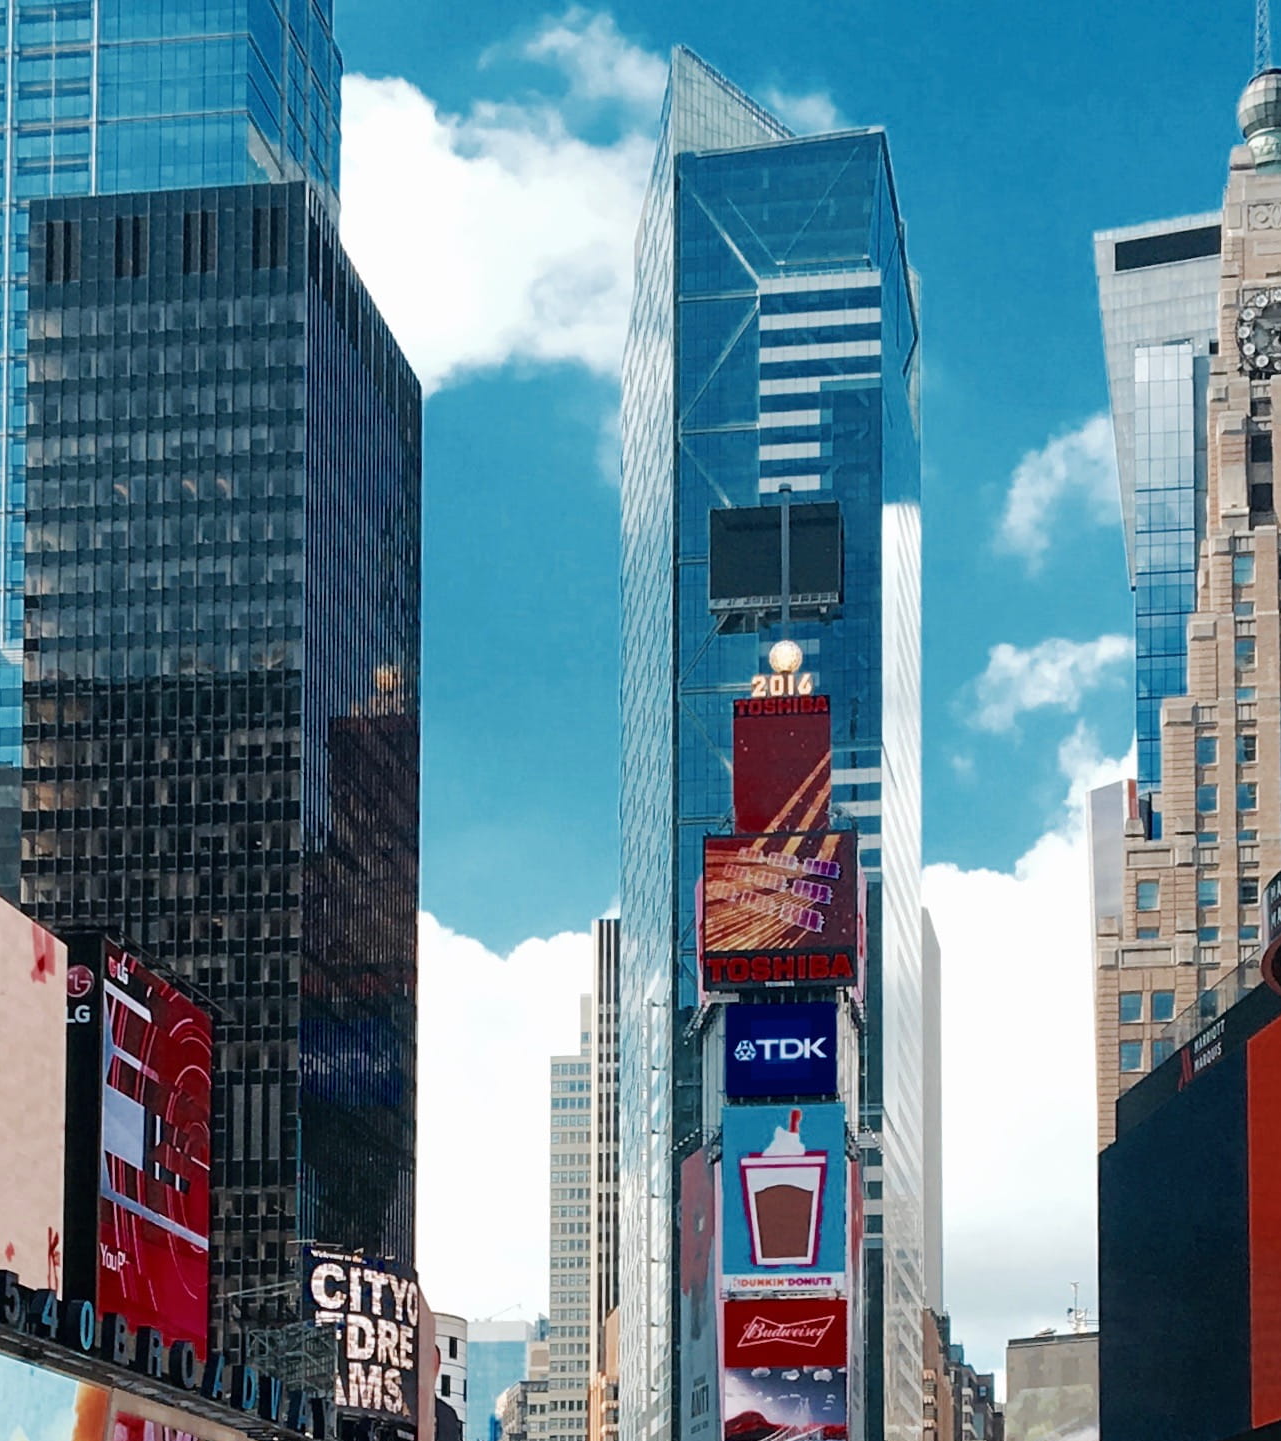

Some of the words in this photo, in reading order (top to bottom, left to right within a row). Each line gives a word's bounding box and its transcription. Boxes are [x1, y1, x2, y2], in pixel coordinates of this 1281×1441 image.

[751, 674, 812, 696] 2016
[735, 697, 828, 715] TOSHIBA
[707, 953, 853, 984] TOSHIBA
[1193, 1018, 1226, 1052] MARRIOTT
[756, 1036, 828, 1059] TDK
[788, 1277, 832, 1287] DONUTS
[744, 1319, 825, 1340] Budweiser
